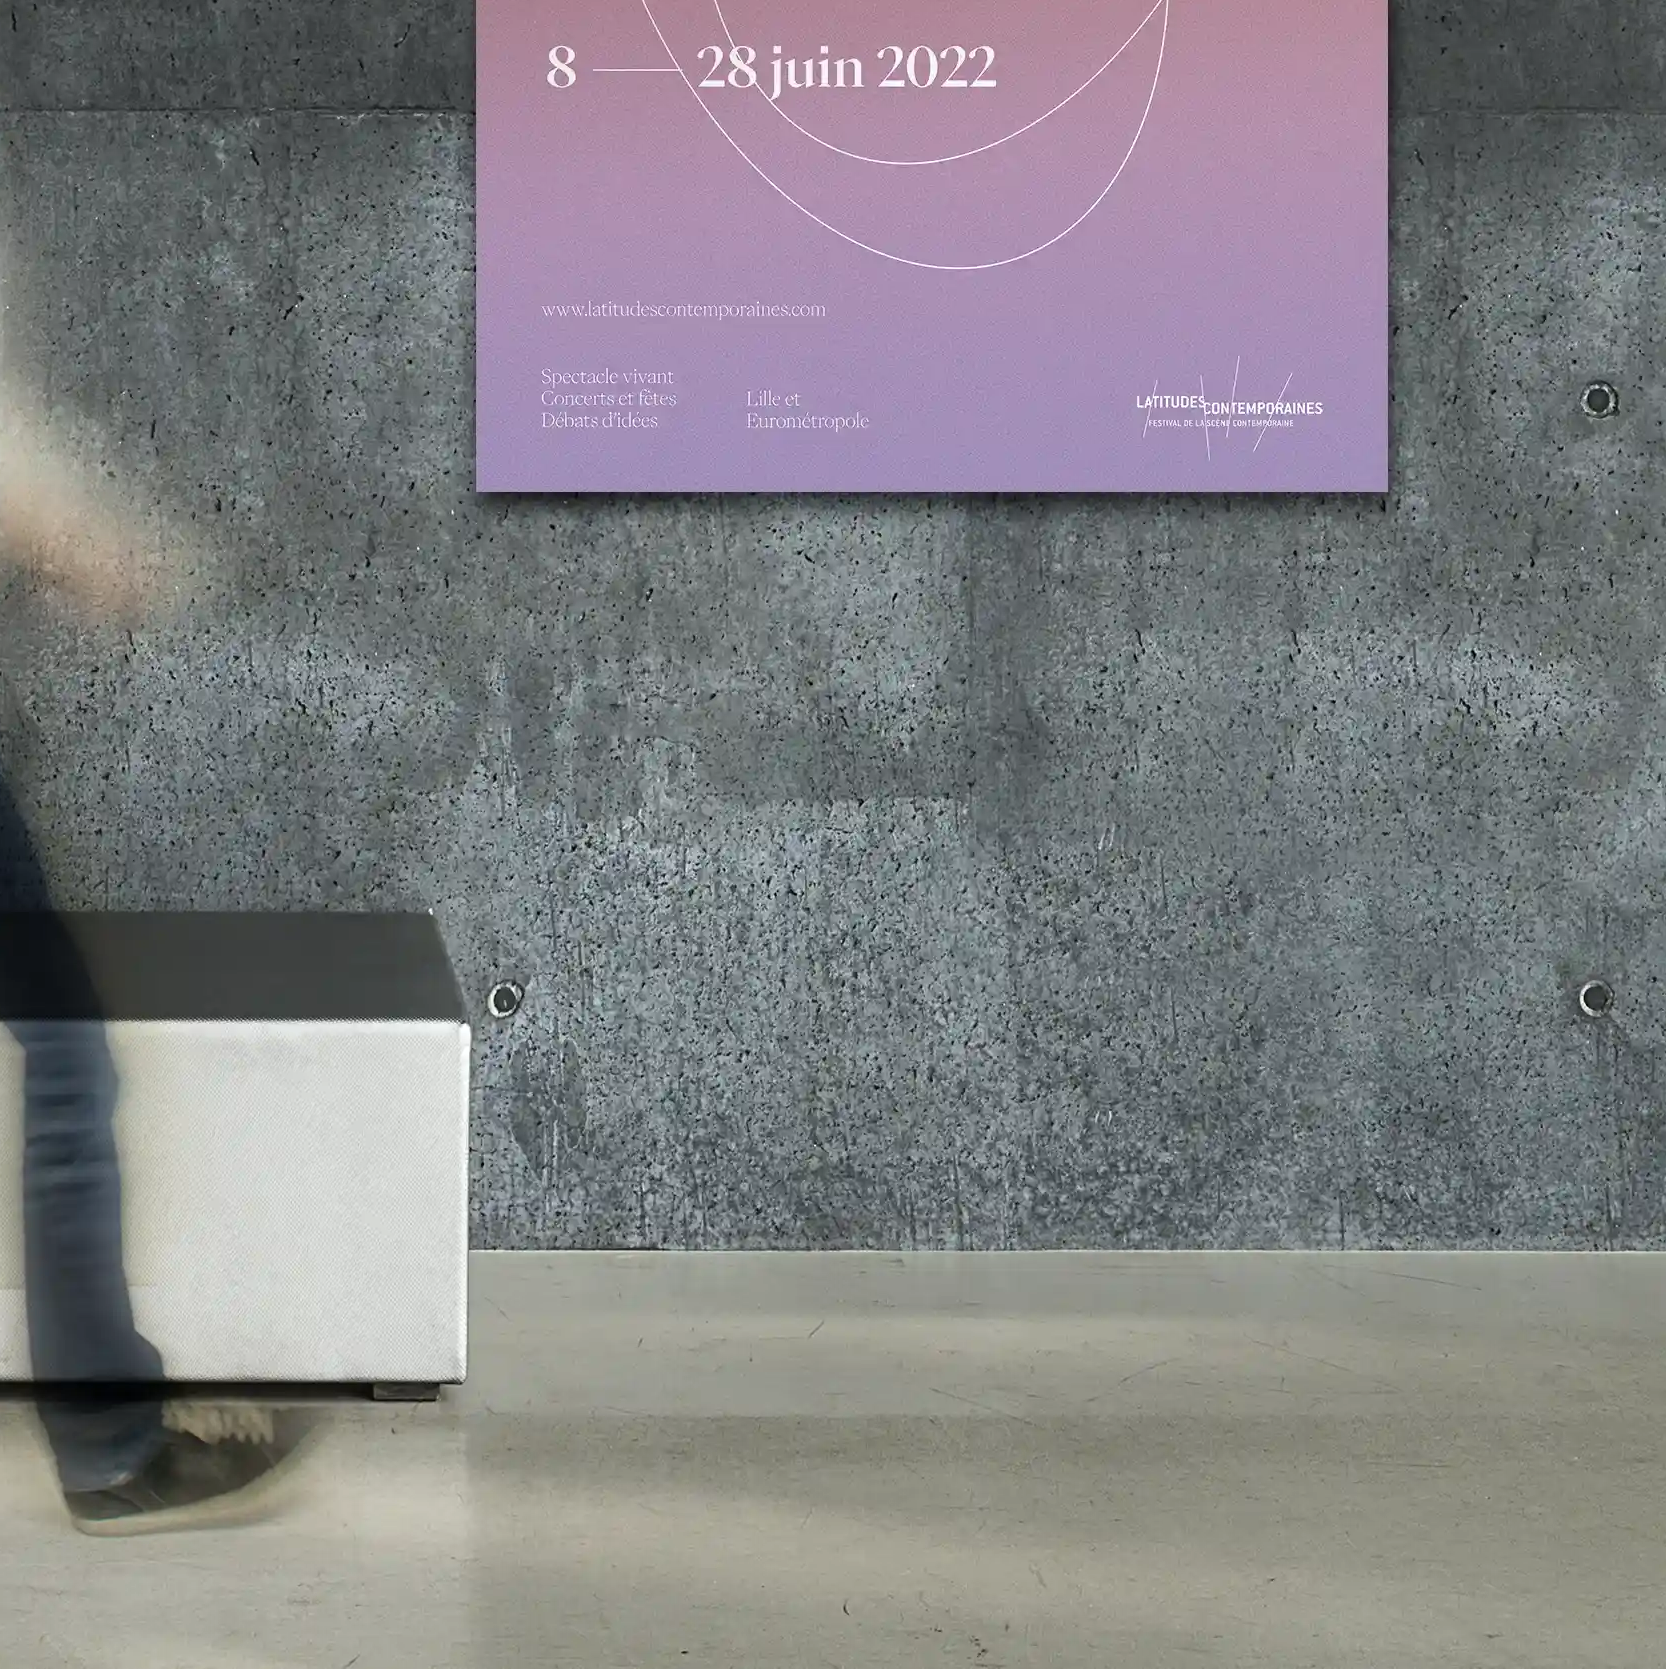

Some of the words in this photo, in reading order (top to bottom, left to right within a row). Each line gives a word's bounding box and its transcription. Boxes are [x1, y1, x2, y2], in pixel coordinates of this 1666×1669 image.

[546, 45, 577, 89] 8
[696, 45, 758, 89] 28
[767, 45, 865, 101] juin
[876, 45, 997, 89] 2022
[541, 300, 827, 321] www.latitudescontemporaines.com
[541, 367, 619, 388] Spectacle
[622, 368, 674, 385] vivant
[541, 390, 615, 407] Concerts
[618, 392, 634, 406] et
[638, 388, 677, 407] fêtes
[746, 389, 781, 407] Lille
[784, 392, 801, 407] et
[1136, 395, 1205, 409] LATITUDES
[1204, 401, 1323, 415] CONTEMPORAINES
[541, 411, 599, 429] Débats
[746, 411, 870, 434] Eurométropole
[1148, 419, 1182, 428] FESTIVAL
[1183, 419, 1193, 428] DE
[1195, 419, 1205, 428] LA
[1232, 419, 1294, 428] CONTEMPORAINE
